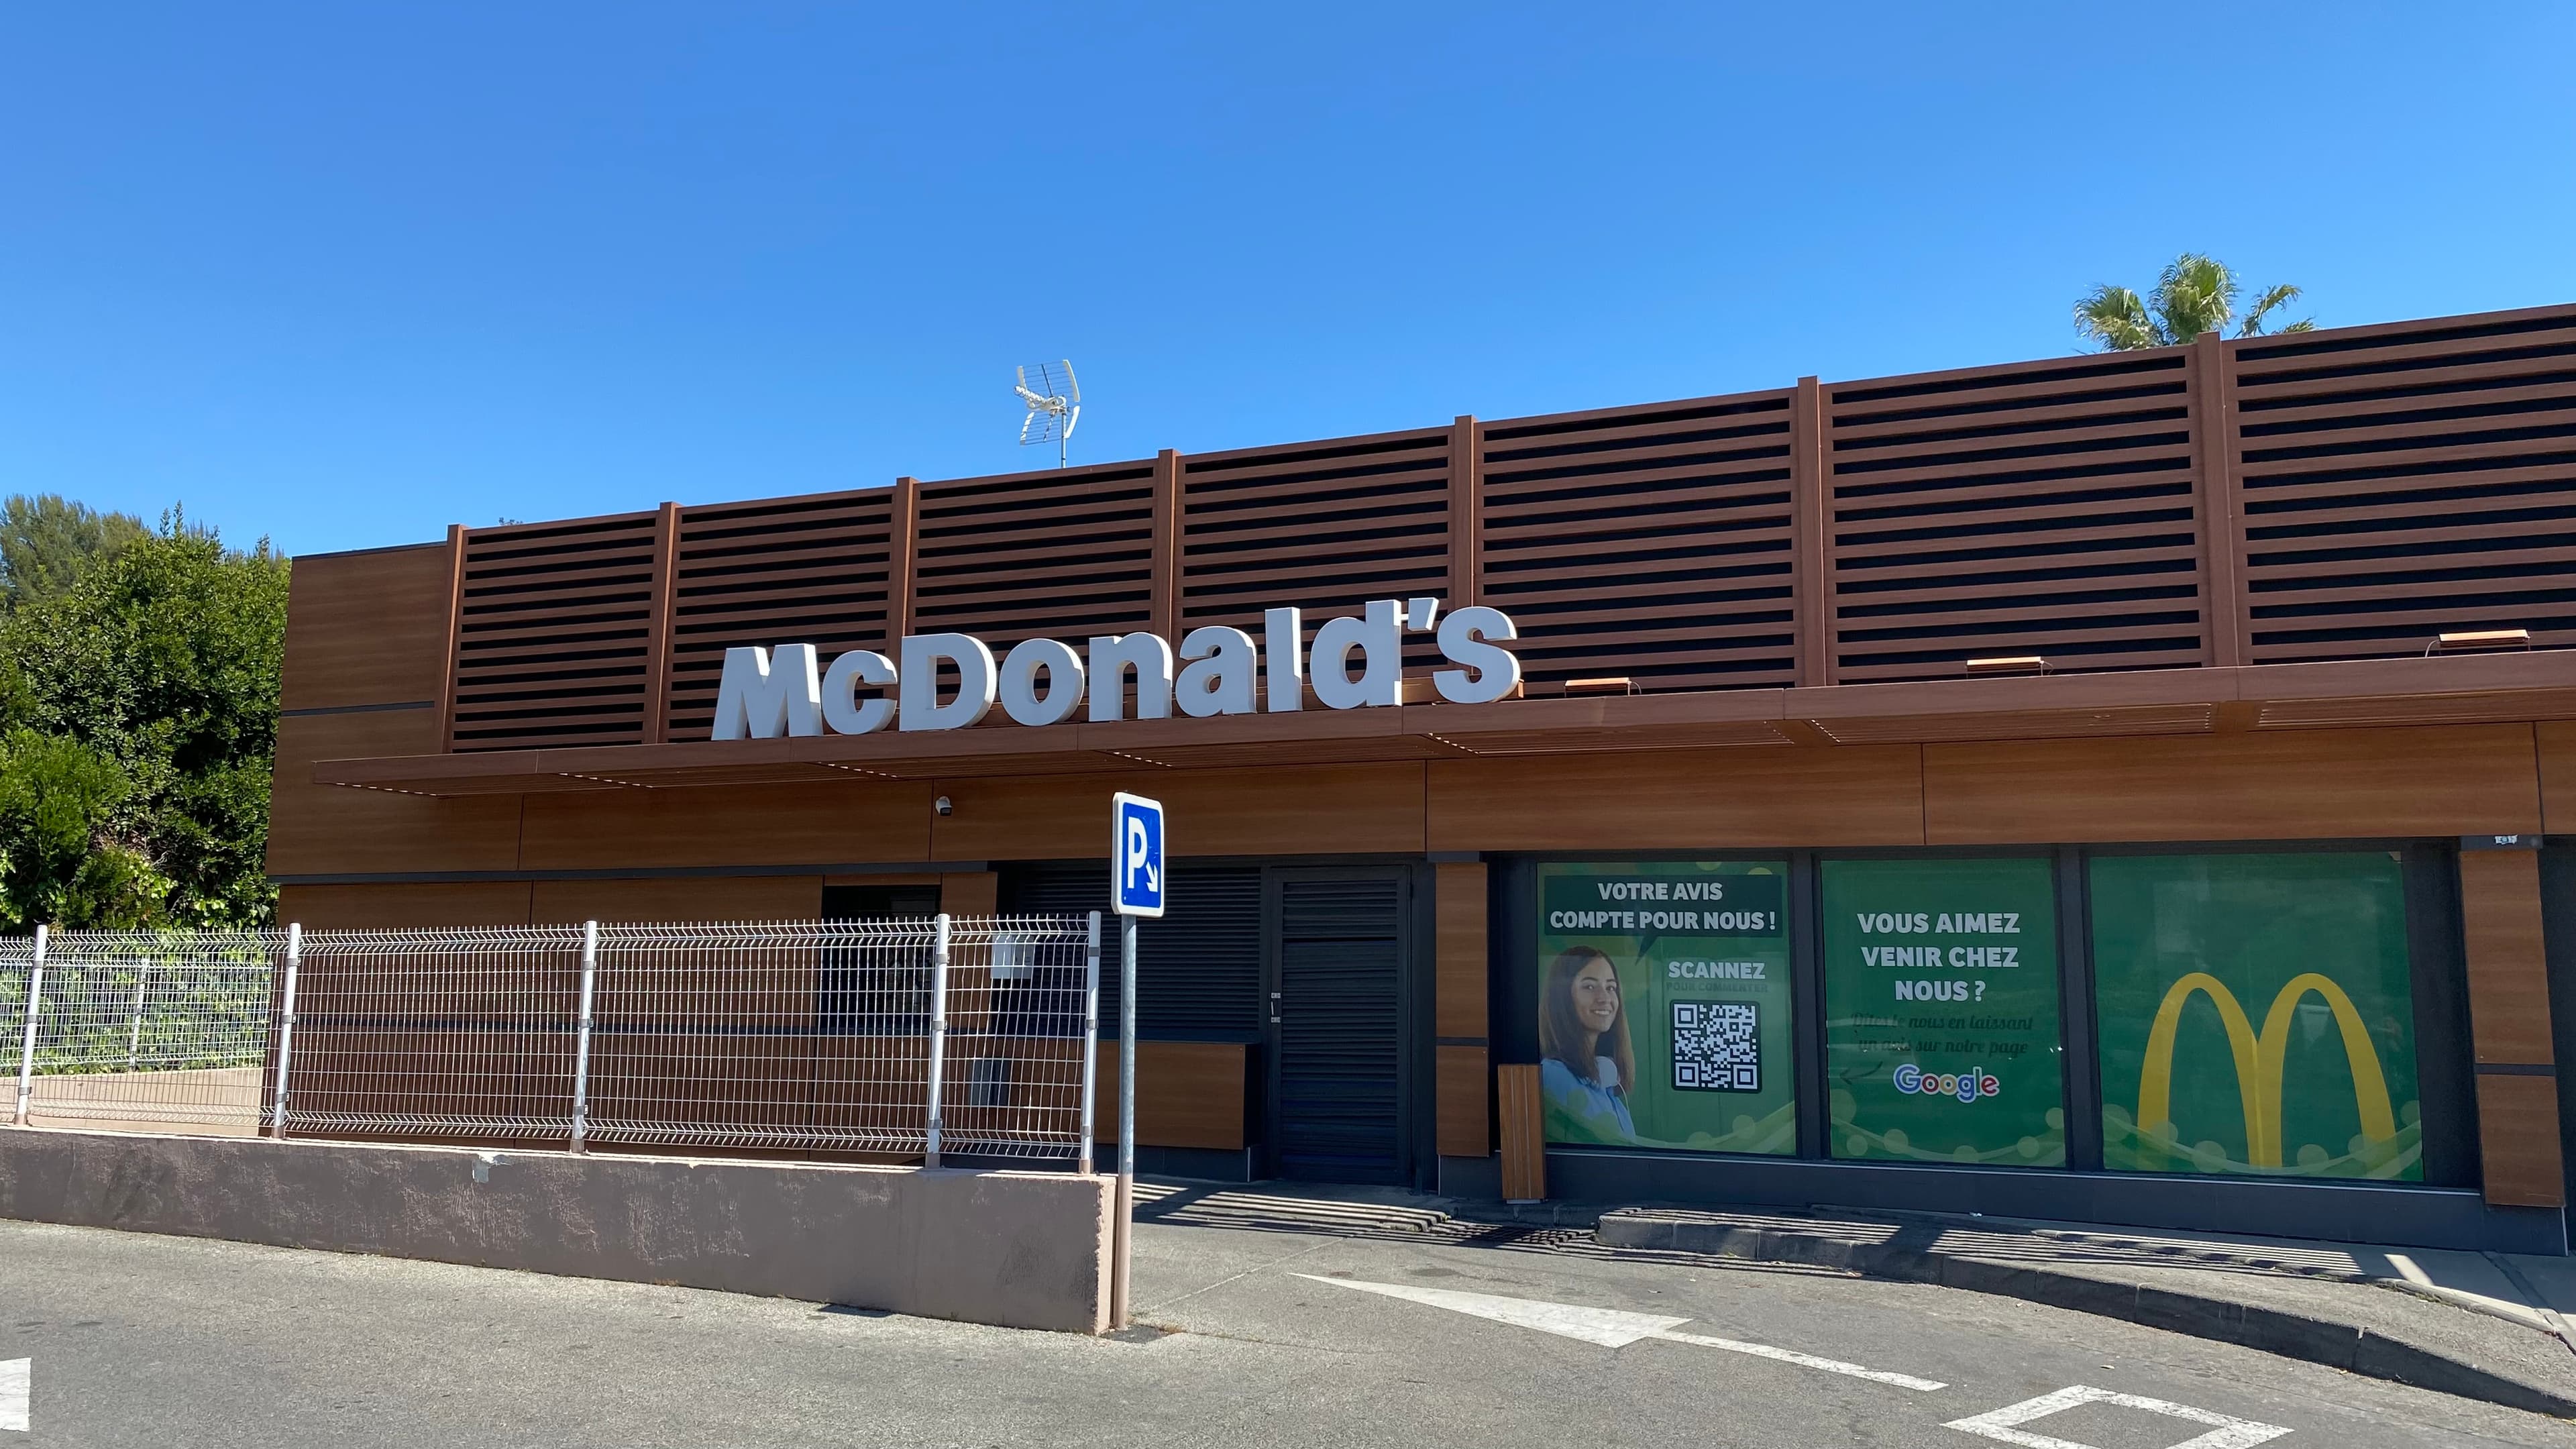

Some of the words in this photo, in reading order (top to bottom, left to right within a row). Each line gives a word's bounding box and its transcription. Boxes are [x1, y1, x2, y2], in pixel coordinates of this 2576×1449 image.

[711, 597, 1521, 741] McDonald's
[1127, 816, 1148, 890] P
[1597, 882, 1668, 901] VOTRE
[1672, 882, 1723, 901] AVIS
[1550, 910, 1634, 929] COMPTE
[1640, 911, 1699, 930] POUR
[1703, 911, 1765, 931] NOUS
[1857, 913, 1929, 934] VOUS
[1935, 913, 2021, 934] AIMEZ
[1861, 947, 1943, 967] VENIR
[1948, 947, 2019, 968] CHEZ
[1668, 961, 1766, 979] SCANNEZ
[1894, 980, 1970, 1002] NOUS
[1908, 1018, 1945, 1028] nous
[1948, 1018, 1966, 1029] en
[1969, 1014, 2033, 1030] laissant
[1915, 1041, 1941, 1052] sur
[1945, 1039, 1986, 1053] notre
[1988, 1041, 2028, 1059] page
[1893, 1063, 2000, 1104] Google
